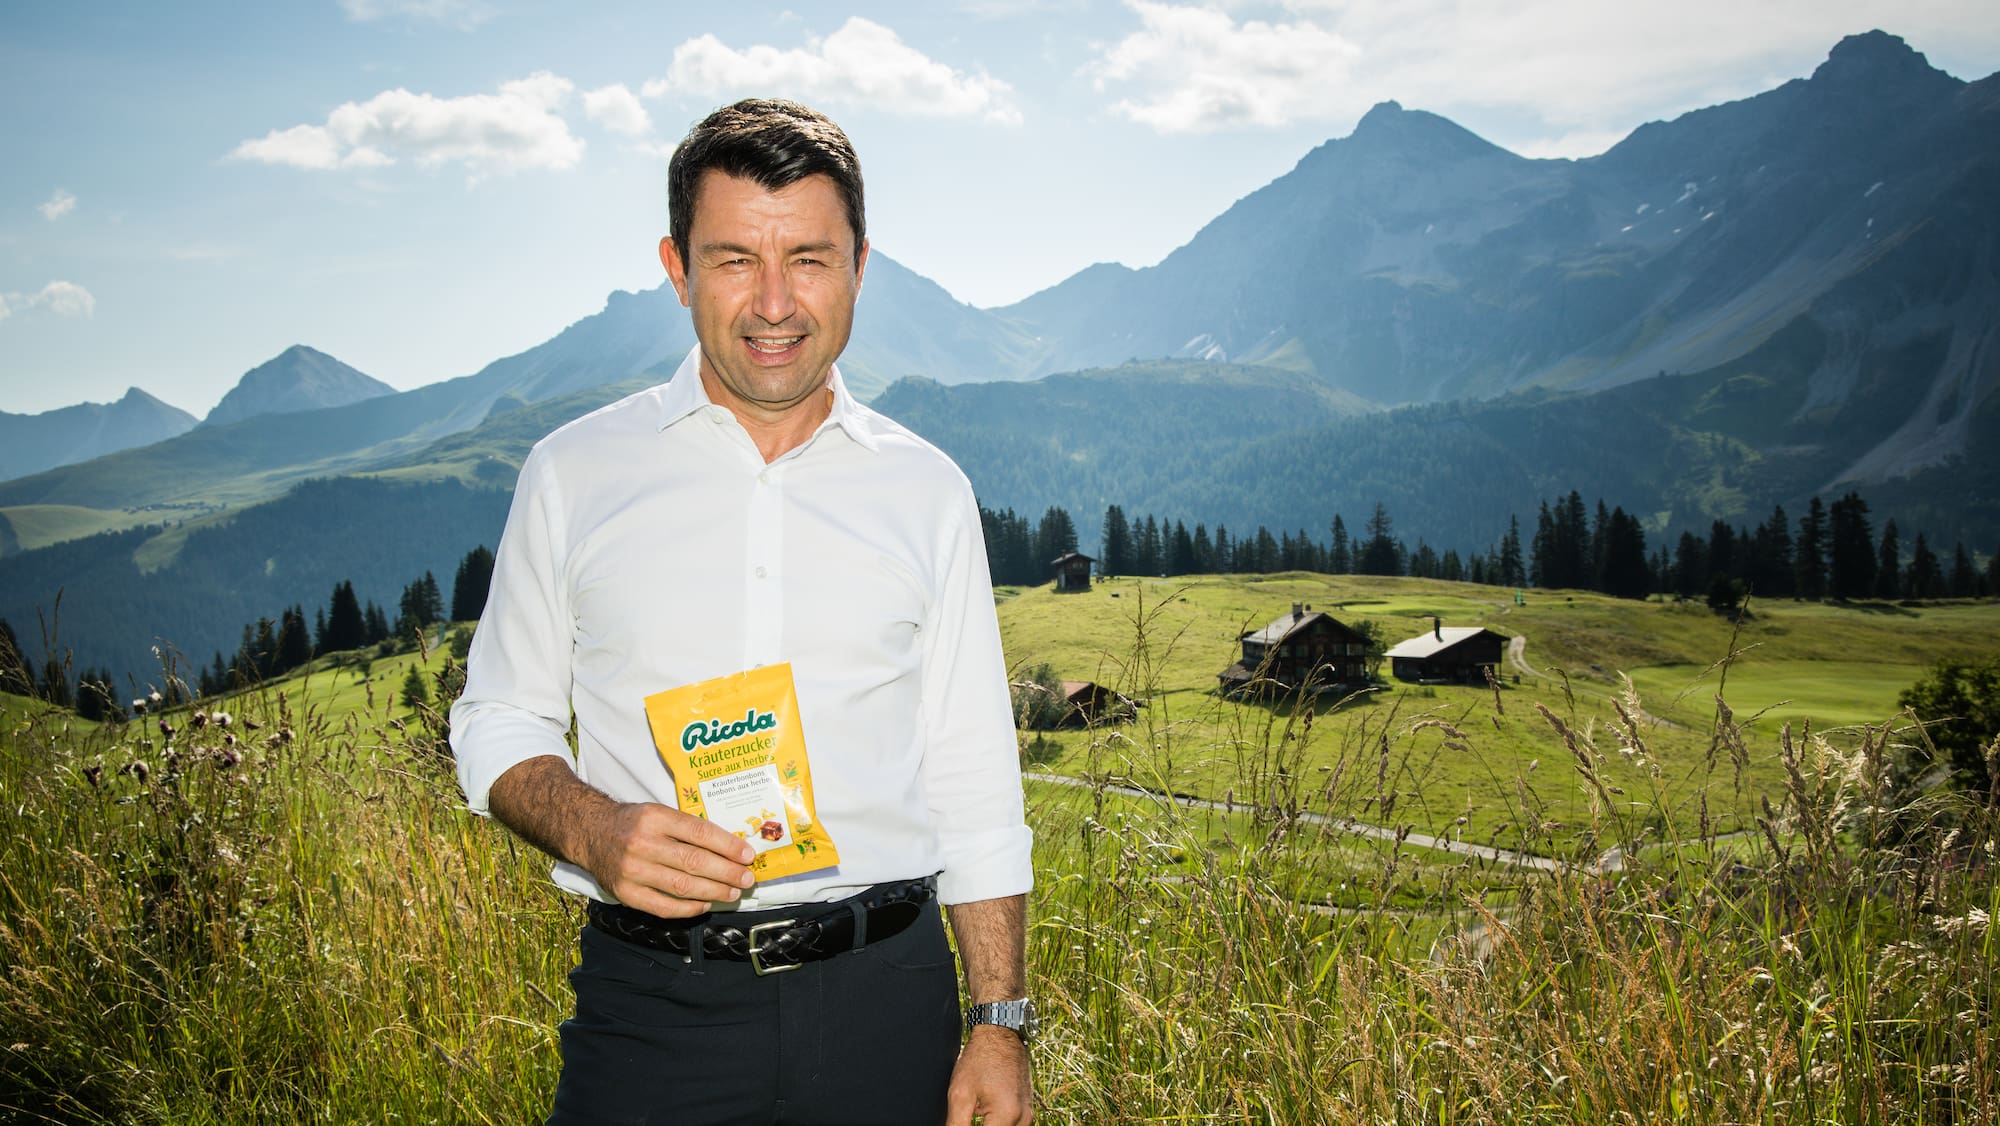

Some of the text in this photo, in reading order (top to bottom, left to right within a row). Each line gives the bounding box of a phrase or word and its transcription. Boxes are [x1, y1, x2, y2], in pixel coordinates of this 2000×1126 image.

[682, 709, 777, 751] Ricola
[689, 737, 776, 769] Kräuterzucker
[697, 753, 775, 780] Sucre aux herbes
[737, 782, 749, 791] aux
